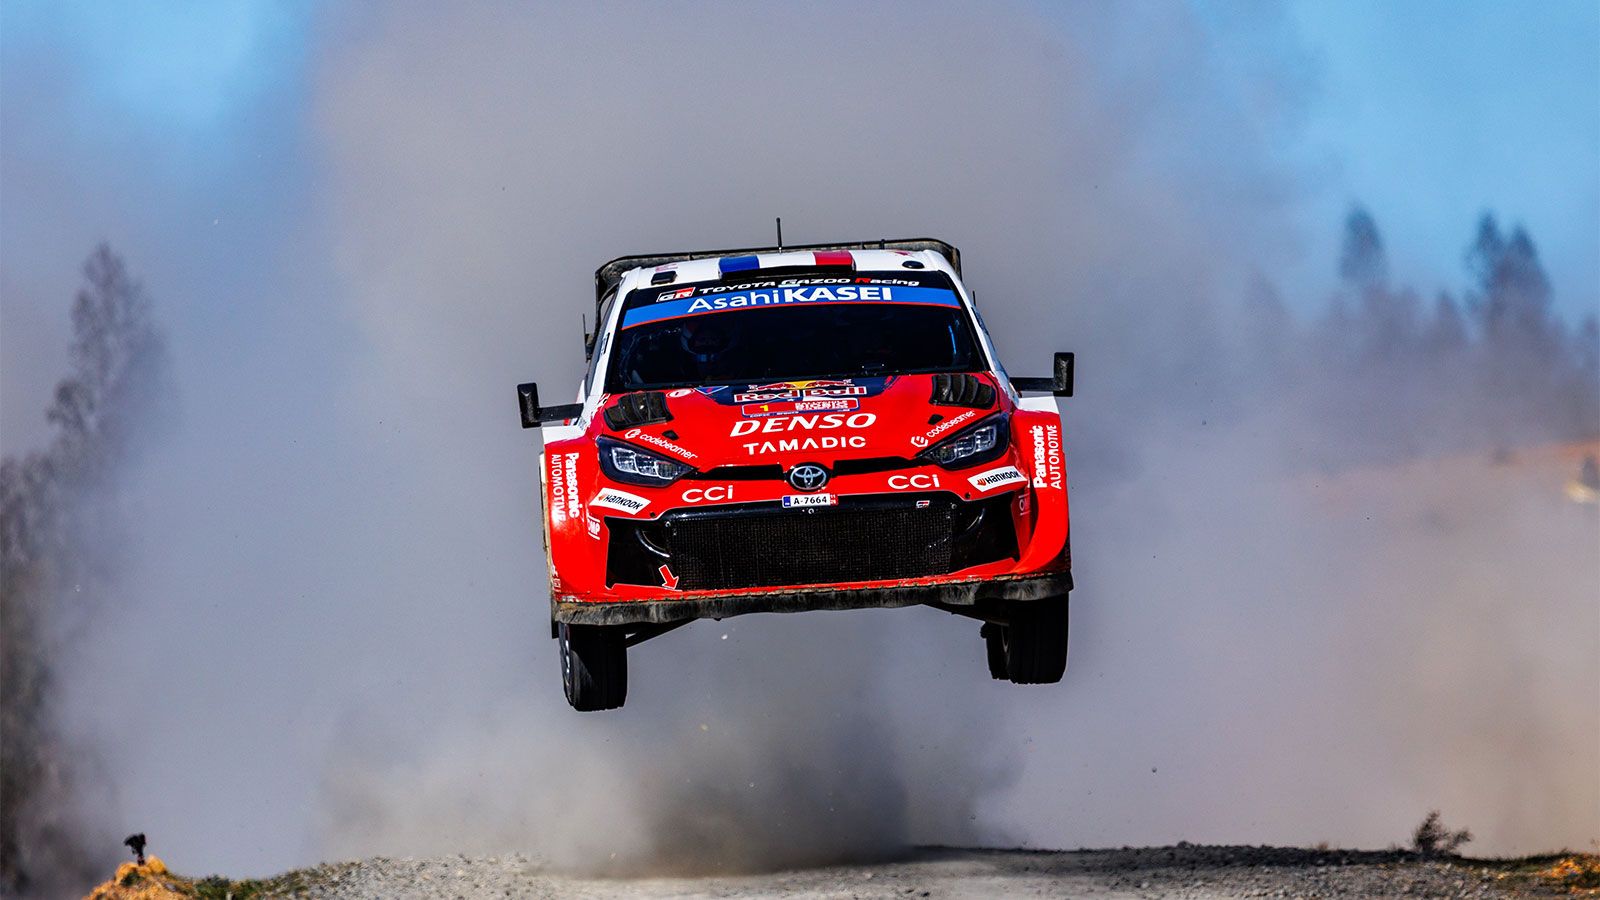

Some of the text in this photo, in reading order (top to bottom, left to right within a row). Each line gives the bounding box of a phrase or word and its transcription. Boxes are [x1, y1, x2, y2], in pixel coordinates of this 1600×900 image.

[659, 277, 920, 302] GR TOYOTA GAZOO Racing
[734, 386, 867, 403] Red Bull
[730, 413, 877, 437] DENSO
[926, 410, 976, 438] codebeamer
[640, 433, 698, 459] codebeamer
[743, 436, 867, 455] TAMADIC
[1029, 425, 1048, 488] Panasonic
[1046, 425, 1062, 490] AUTOMOTIVE
[551, 454, 567, 522] AUTOMOTIVE
[565, 452, 583, 518] Panasonic
[793, 496, 827, 505] A-7664
